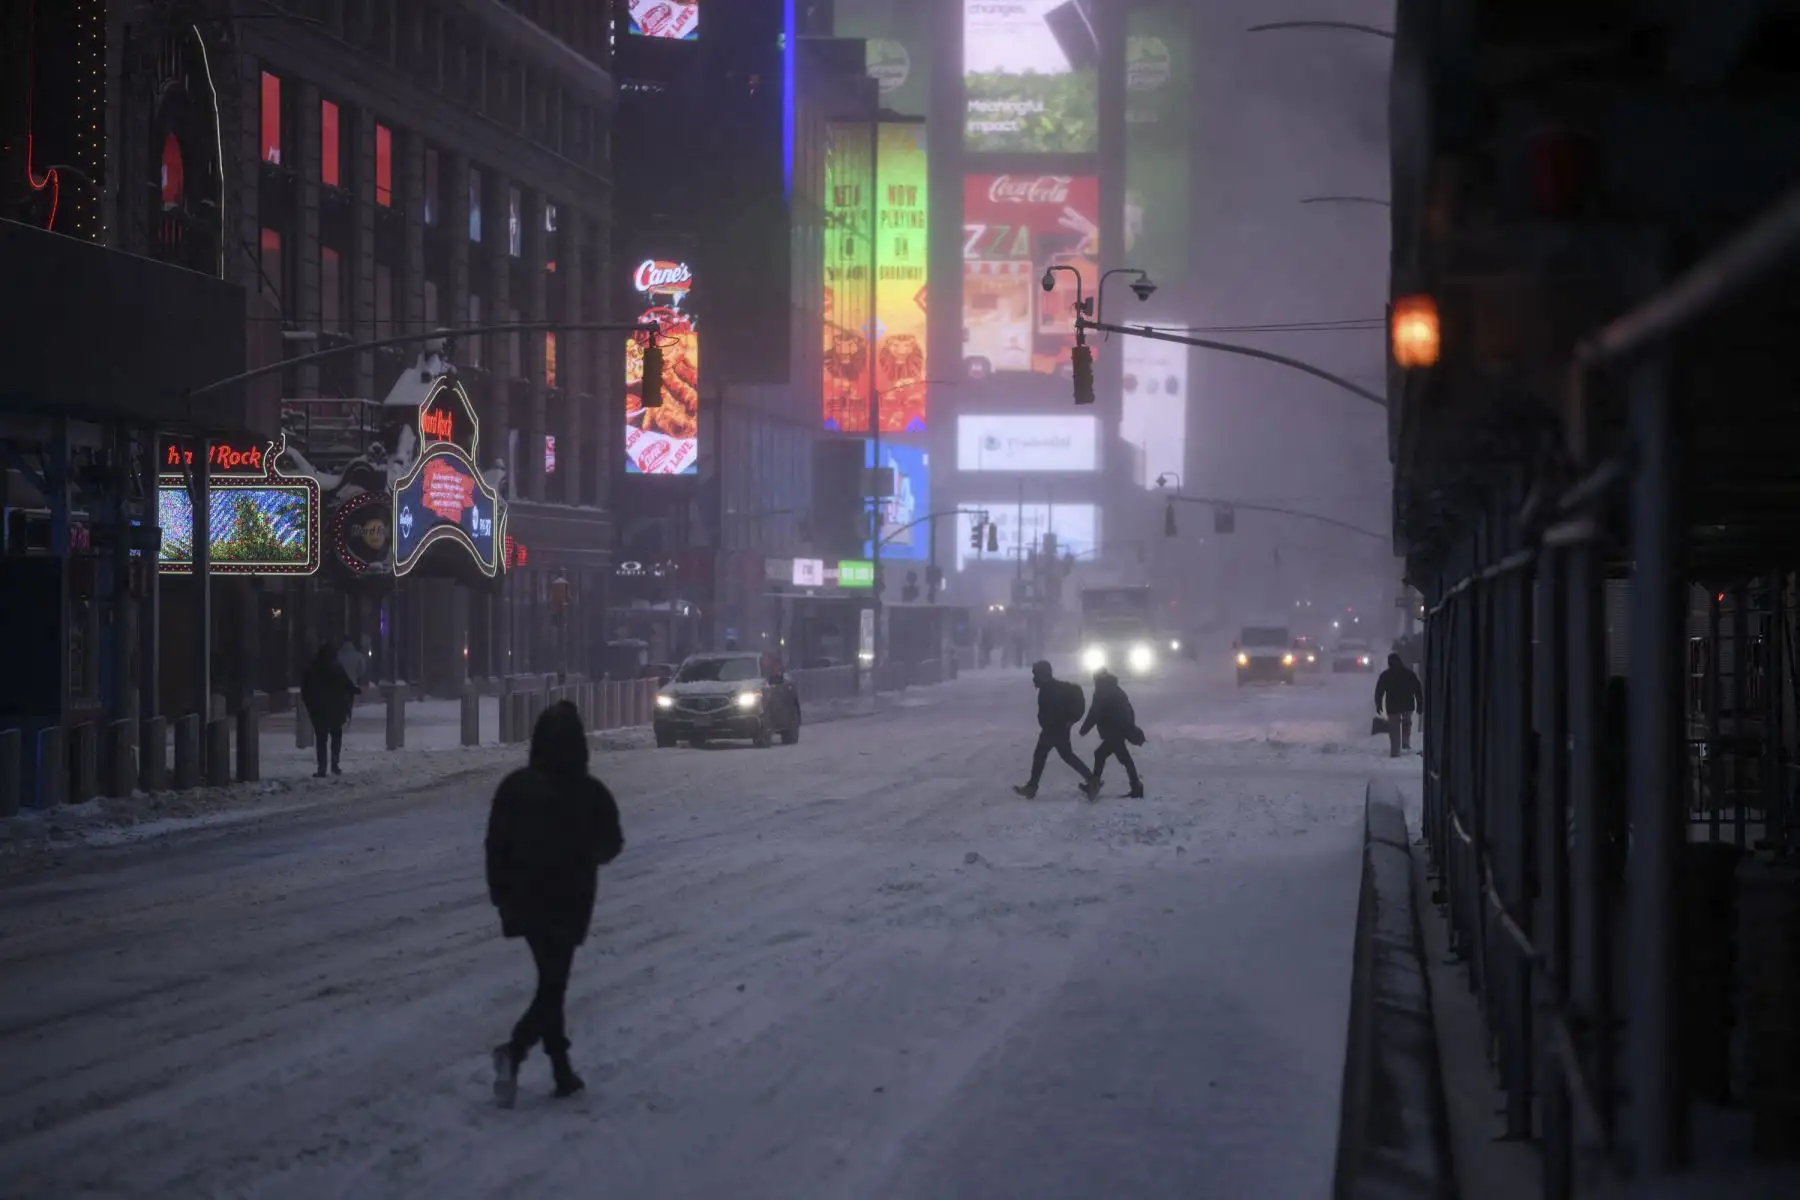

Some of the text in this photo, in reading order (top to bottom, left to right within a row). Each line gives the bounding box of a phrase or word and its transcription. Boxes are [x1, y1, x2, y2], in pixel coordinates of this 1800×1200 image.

[888, 184, 918, 207] NOW
[881, 209, 925, 229] PLAYING
[635, 259, 692, 291] Cane's
[879, 265, 923, 281] BROADWAY
[217, 444, 261, 469] Rock
